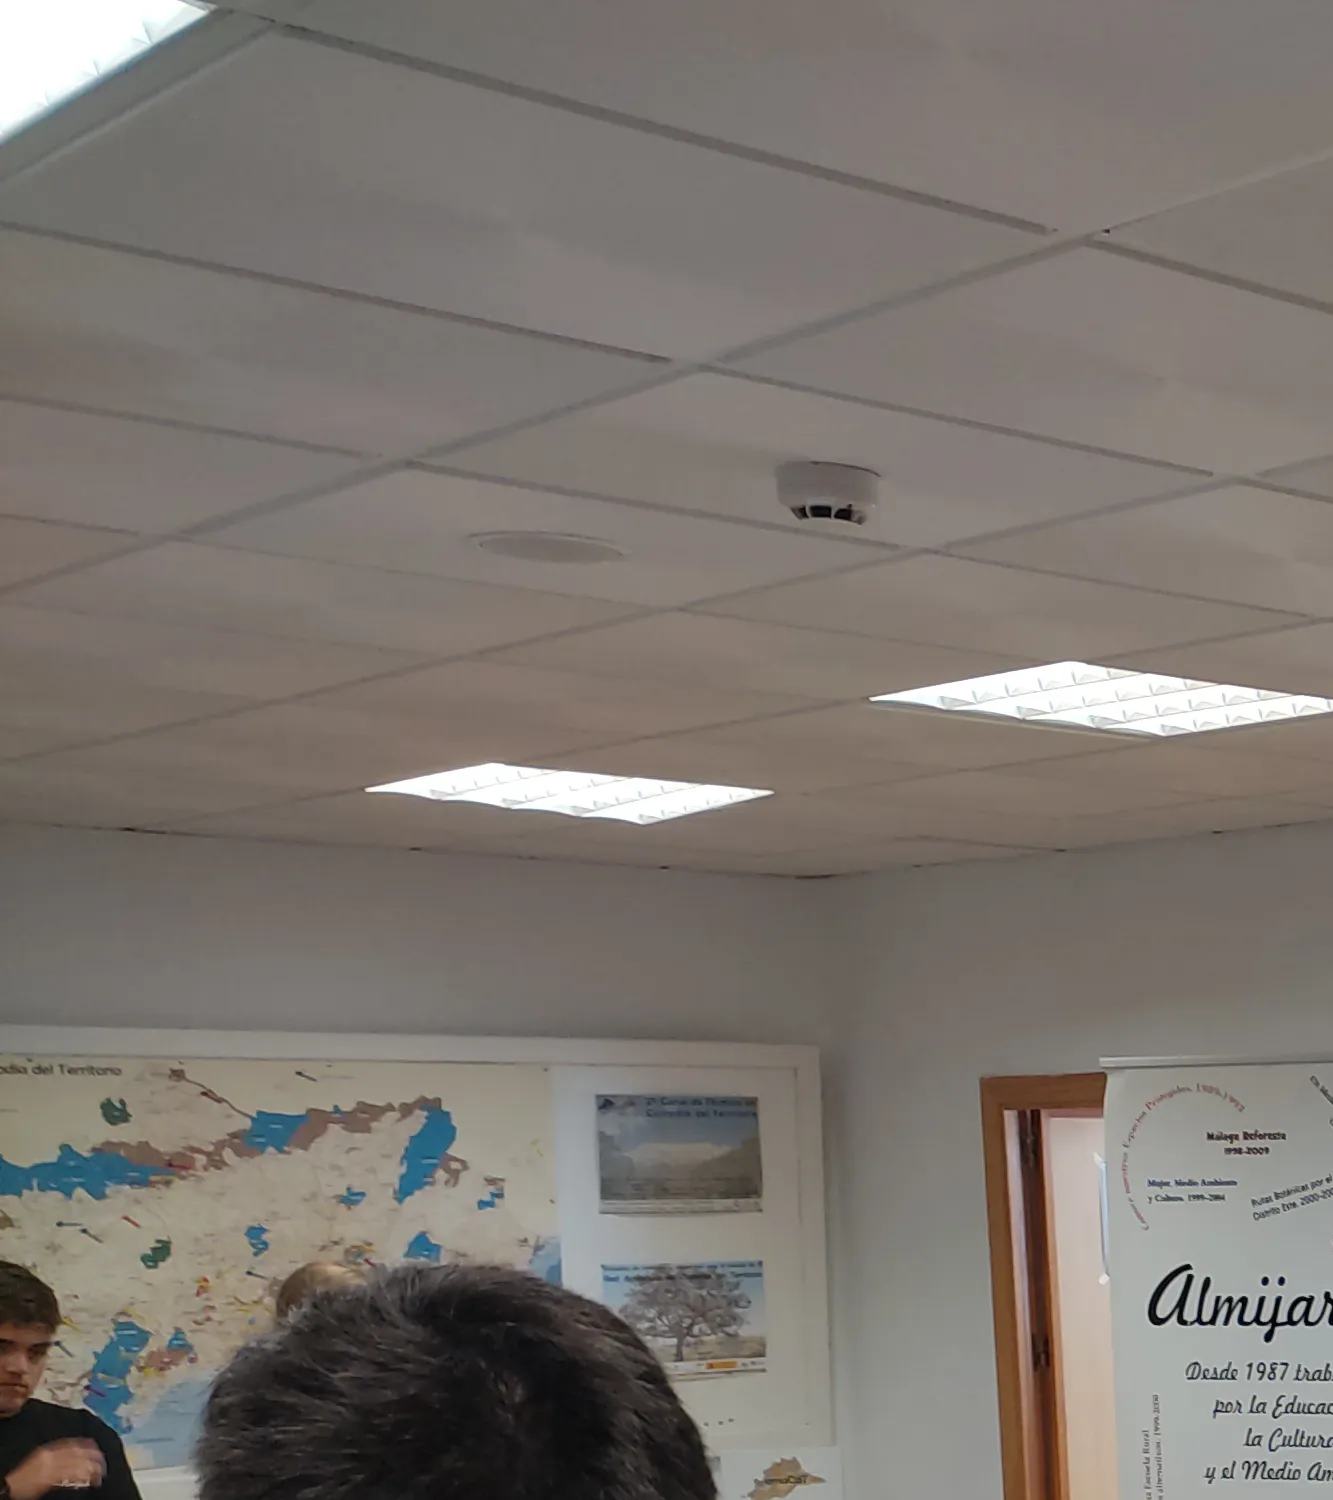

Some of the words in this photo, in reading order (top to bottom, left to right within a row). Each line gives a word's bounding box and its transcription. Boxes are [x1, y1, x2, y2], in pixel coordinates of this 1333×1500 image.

[1185, 1361, 1238, 1380] Desde
[1246, 1362, 1289, 1381] 1987
[1212, 1398, 1242, 1419] por
[1248, 1396, 1266, 1414] la
[1244, 1428, 1262, 1447] la
[1204, 1466, 1216, 1484] y
[1220, 1461, 1236, 1480] el
[1242, 1460, 1301, 1480] Medio
